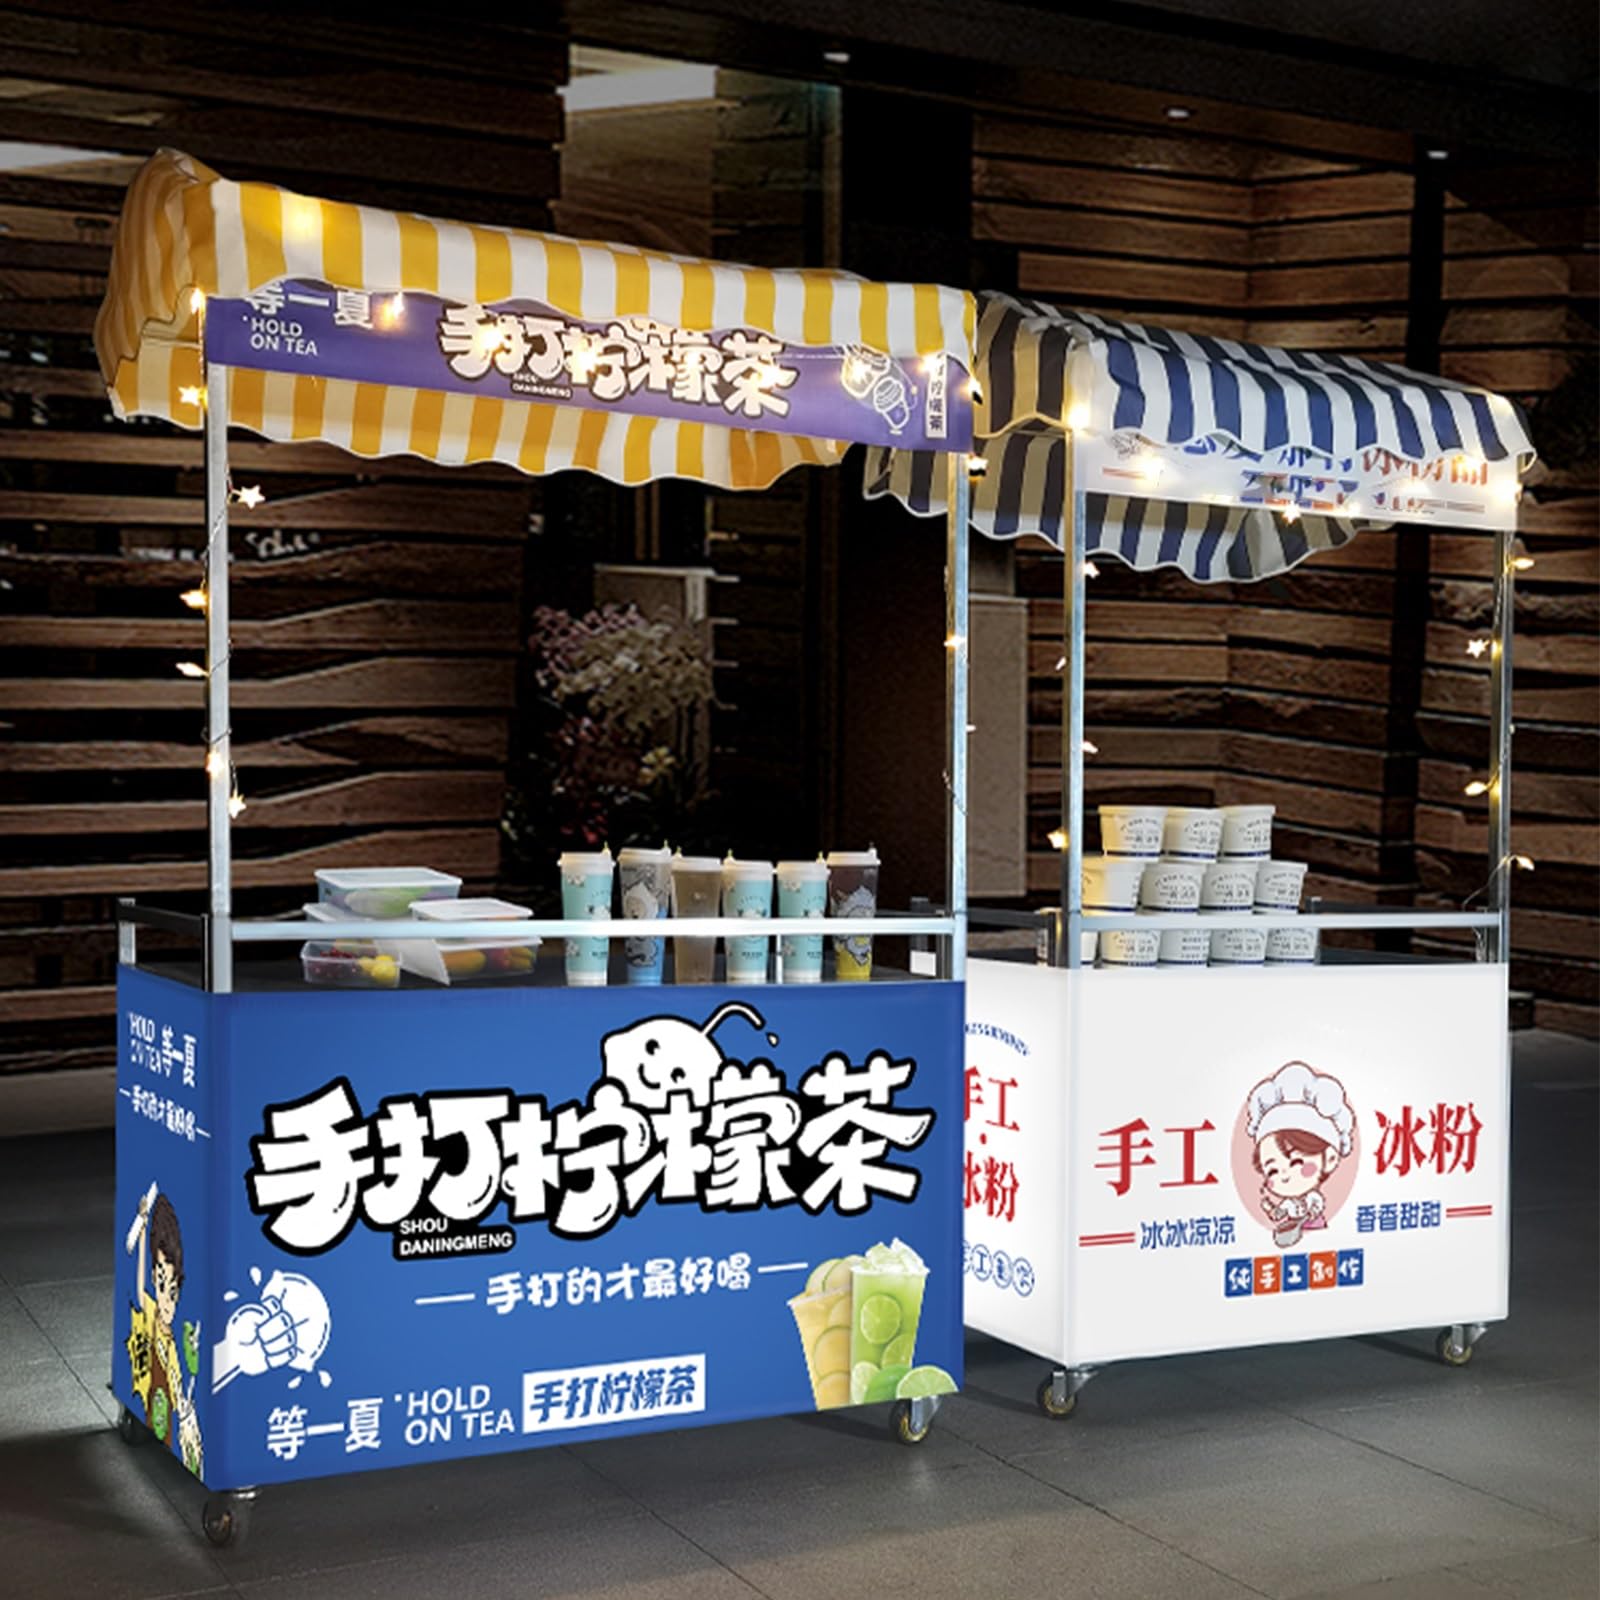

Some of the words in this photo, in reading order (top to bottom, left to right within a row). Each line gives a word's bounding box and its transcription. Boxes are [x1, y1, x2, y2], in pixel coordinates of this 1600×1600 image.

[250, 317, 303, 338] HOLD
[250, 333, 279, 350] ON
[284, 336, 318, 356] TEA
[440, 303, 798, 418] 手打柠檬茶
[161, 1024, 196, 1088] 等一夏
[251, 1055, 935, 1250] 手打柠檬茶
[1094, 1117, 1219, 1196] 手工
[1373, 1101, 1483, 1178] 冰粉
[400, 1217, 448, 1235] SHOU
[400, 1231, 513, 1255] DANINGMENG
[1139, 1214, 1236, 1250] 冰冰凉凉
[1355, 1200, 1441, 1233] 香香甜甜
[486, 1252, 751, 1315] 手打的才最好喝
[1227, 1254, 1361, 1293] 纯手工制作
[407, 1384, 491, 1417] HOLD
[529, 1364, 698, 1424] 手打柠檬茶
[266, 1397, 384, 1461] 等一夏
[405, 1416, 451, 1446] ON
[462, 1408, 515, 1439] TEA
